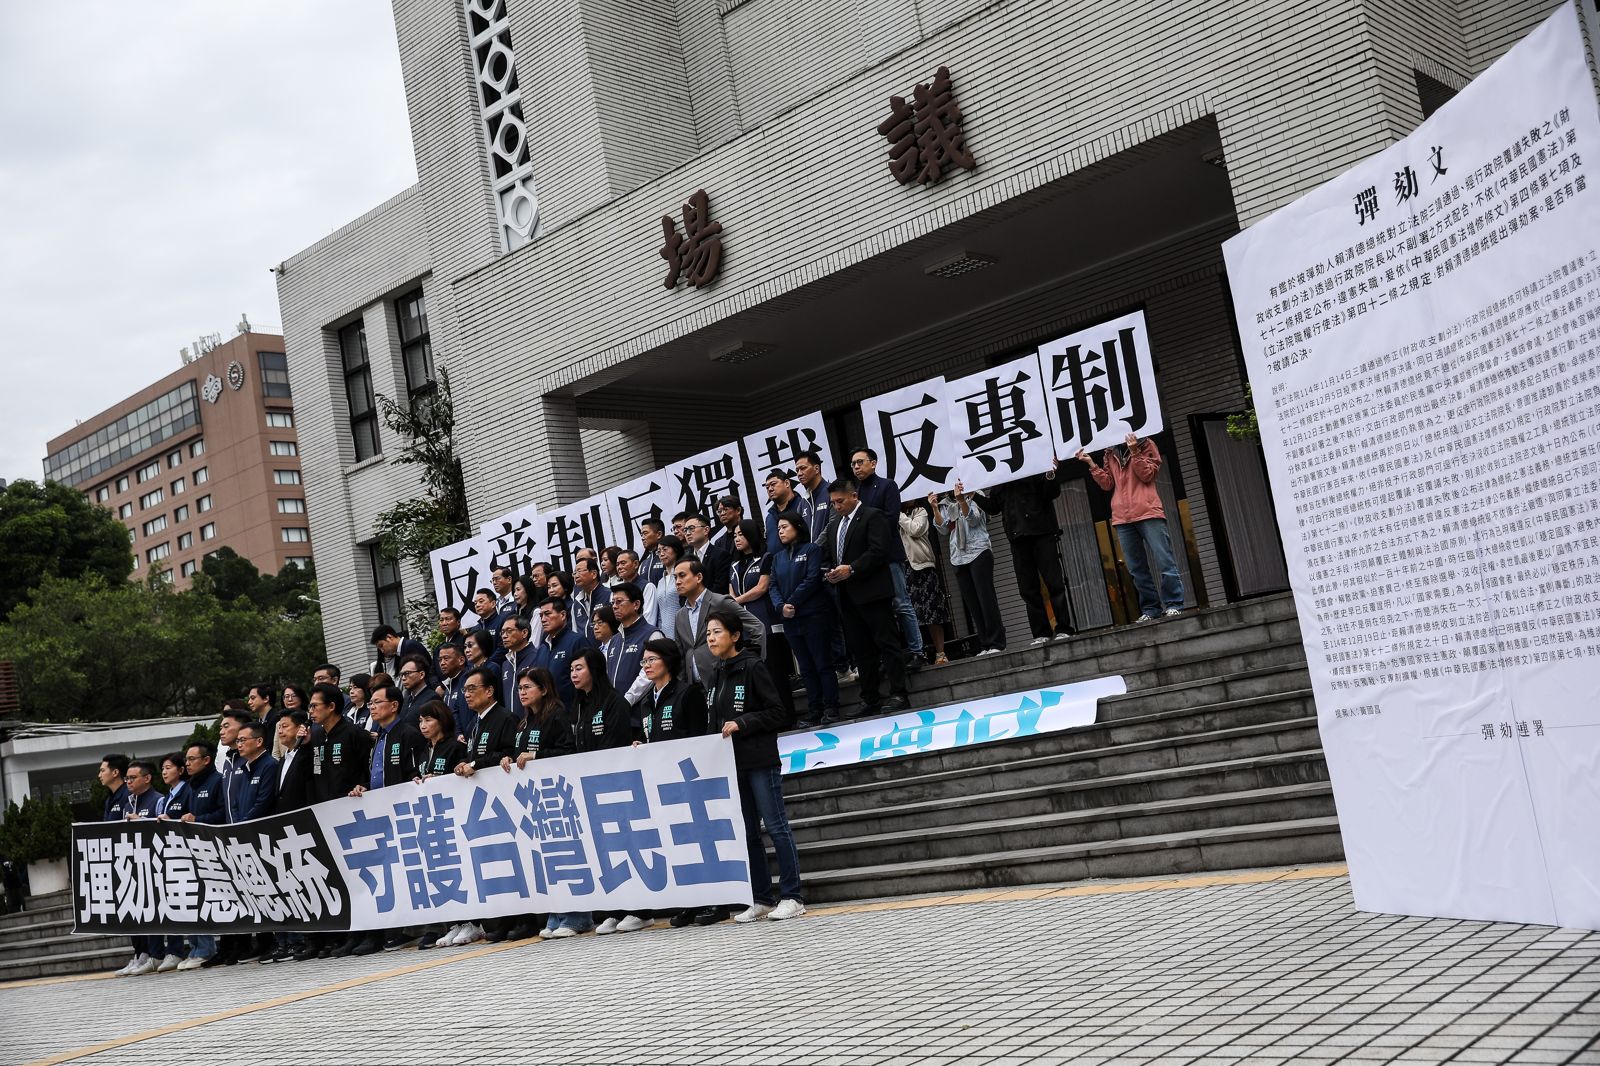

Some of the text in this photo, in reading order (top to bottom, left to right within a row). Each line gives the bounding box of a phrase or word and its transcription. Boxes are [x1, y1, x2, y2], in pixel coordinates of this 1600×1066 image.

[1352, 145, 1448, 226] 彈劾文
[1481, 719, 1544, 740] 彈劾連署
[333, 757, 749, 913] 守護台灣民主
